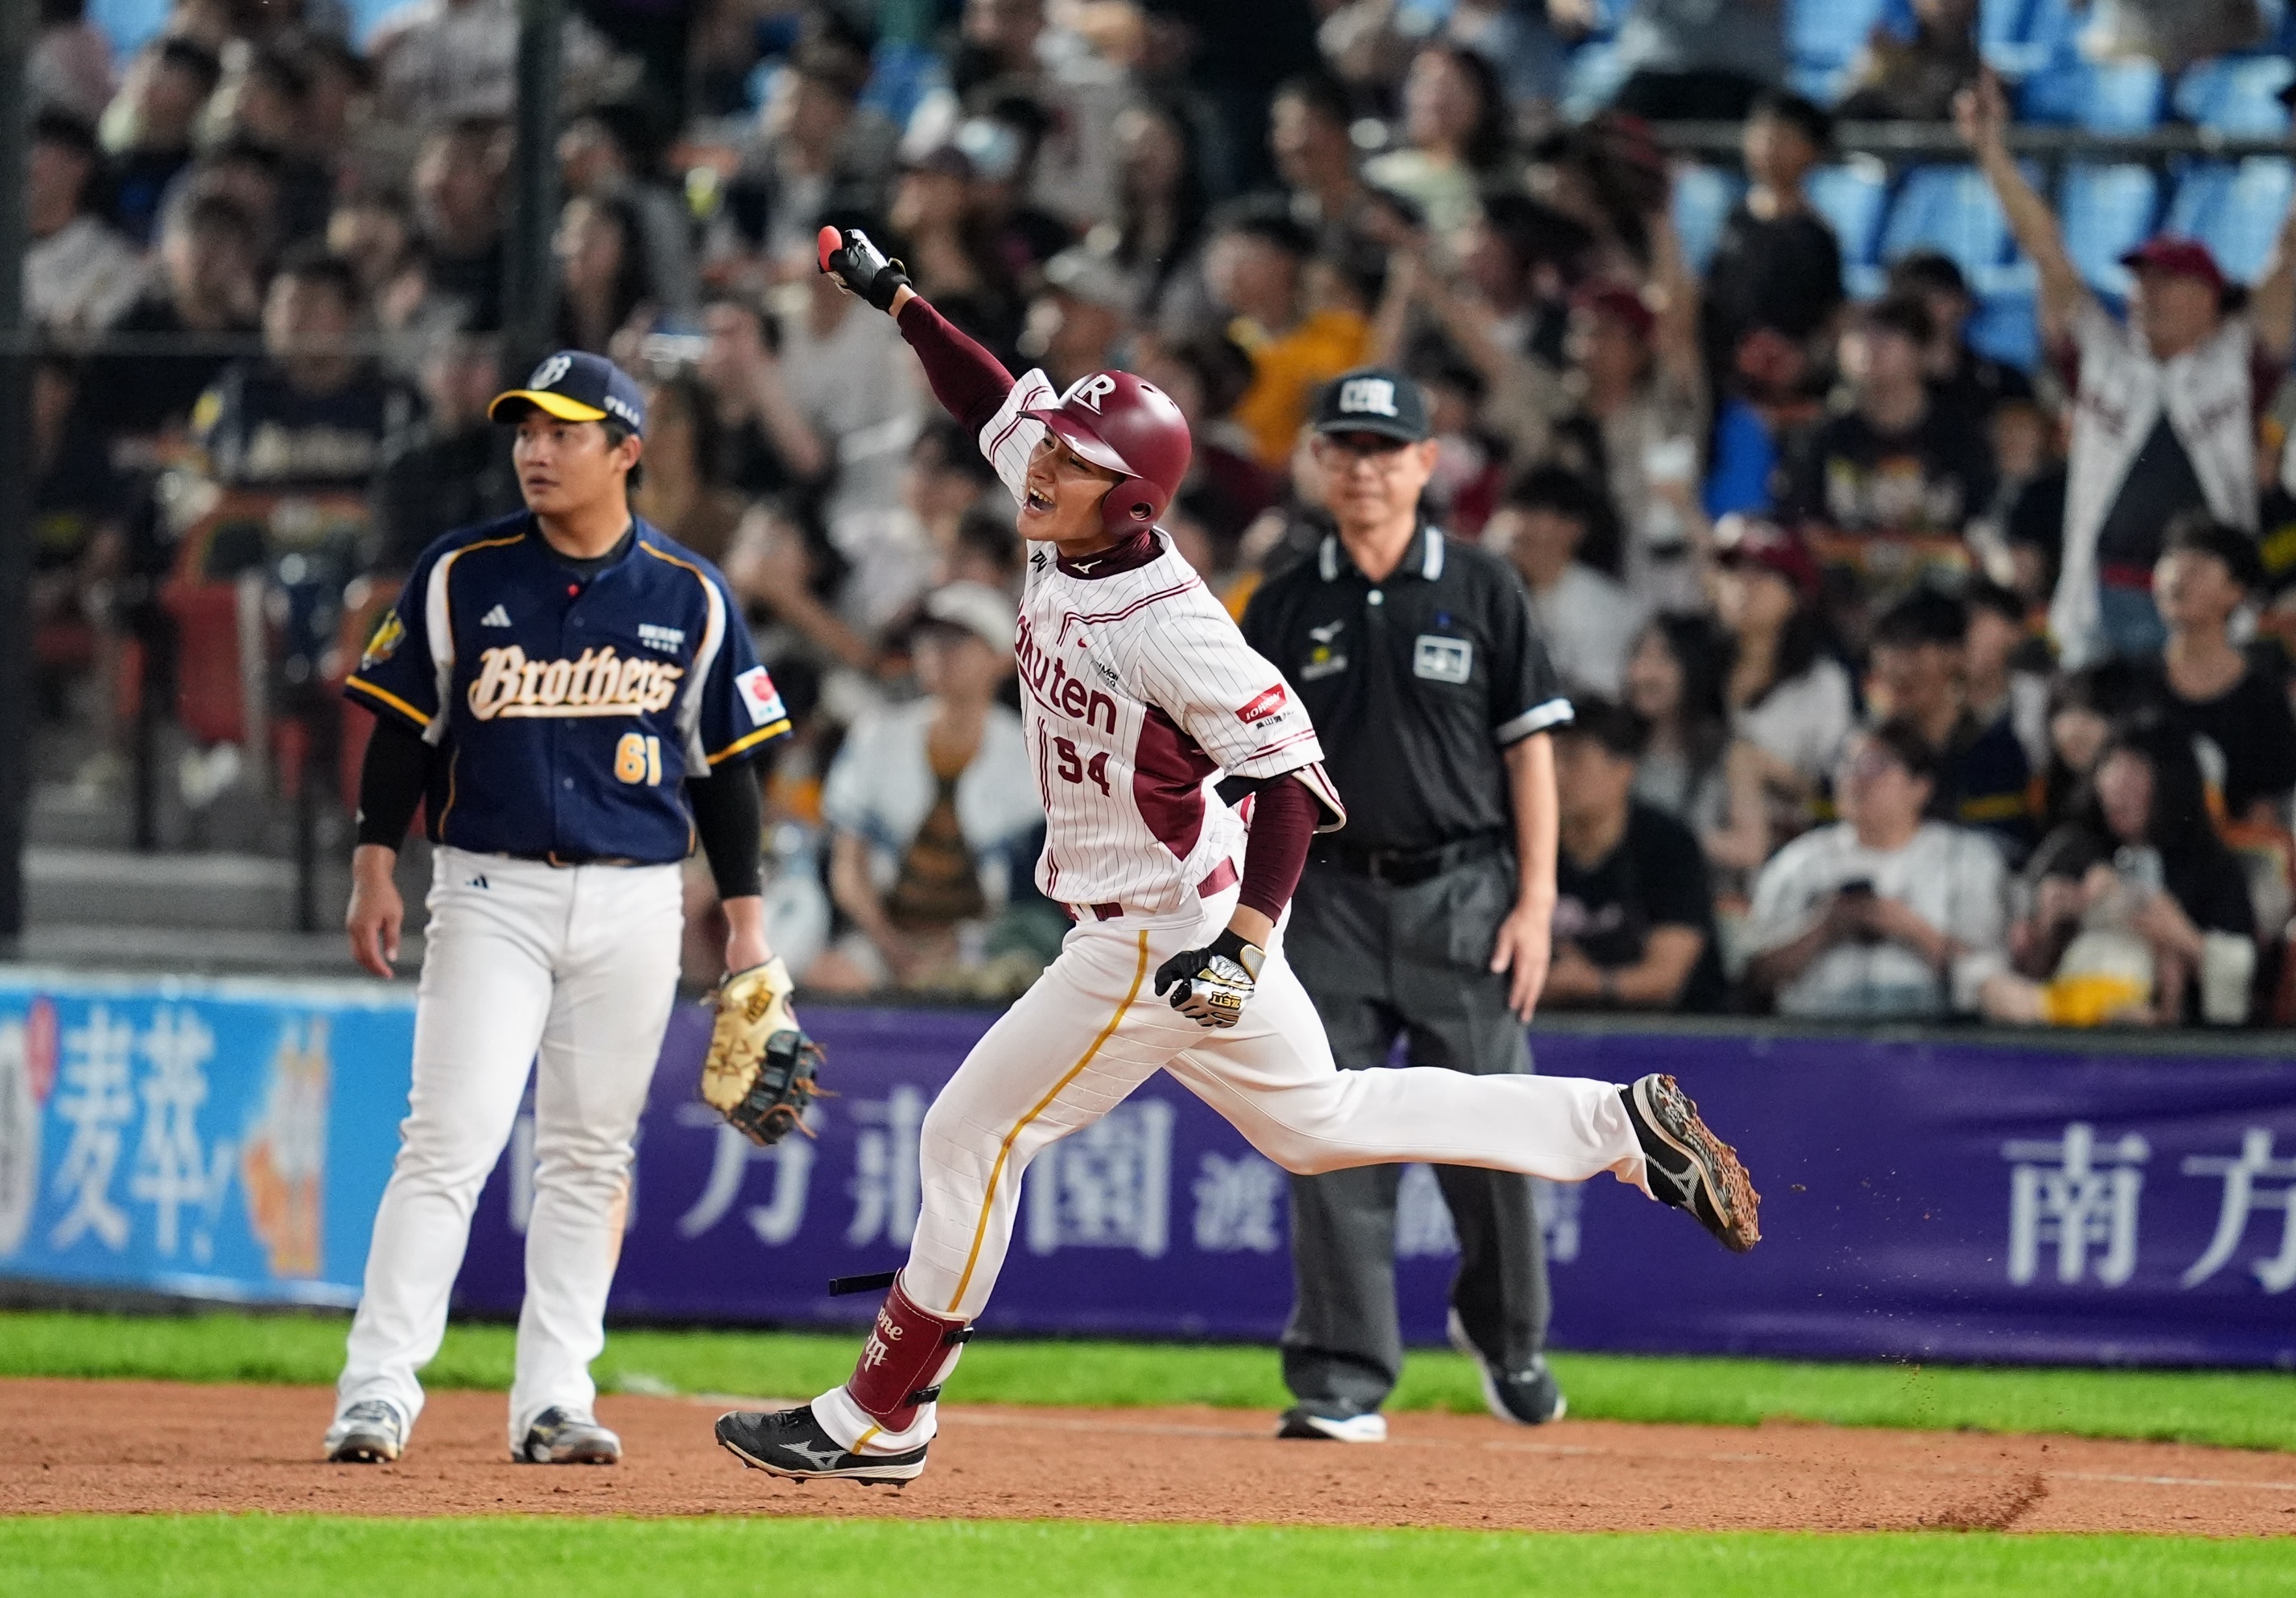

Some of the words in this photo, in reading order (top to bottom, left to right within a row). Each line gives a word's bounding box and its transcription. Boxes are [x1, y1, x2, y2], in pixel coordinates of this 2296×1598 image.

[1071, 373, 1116, 416] R
[467, 645, 686, 721] Brothers
[1015, 615, 1117, 735] akuten
[614, 731, 662, 787] 61
[1053, 736, 1111, 798] 54
[2001, 1122, 2296, 1294] 南方
